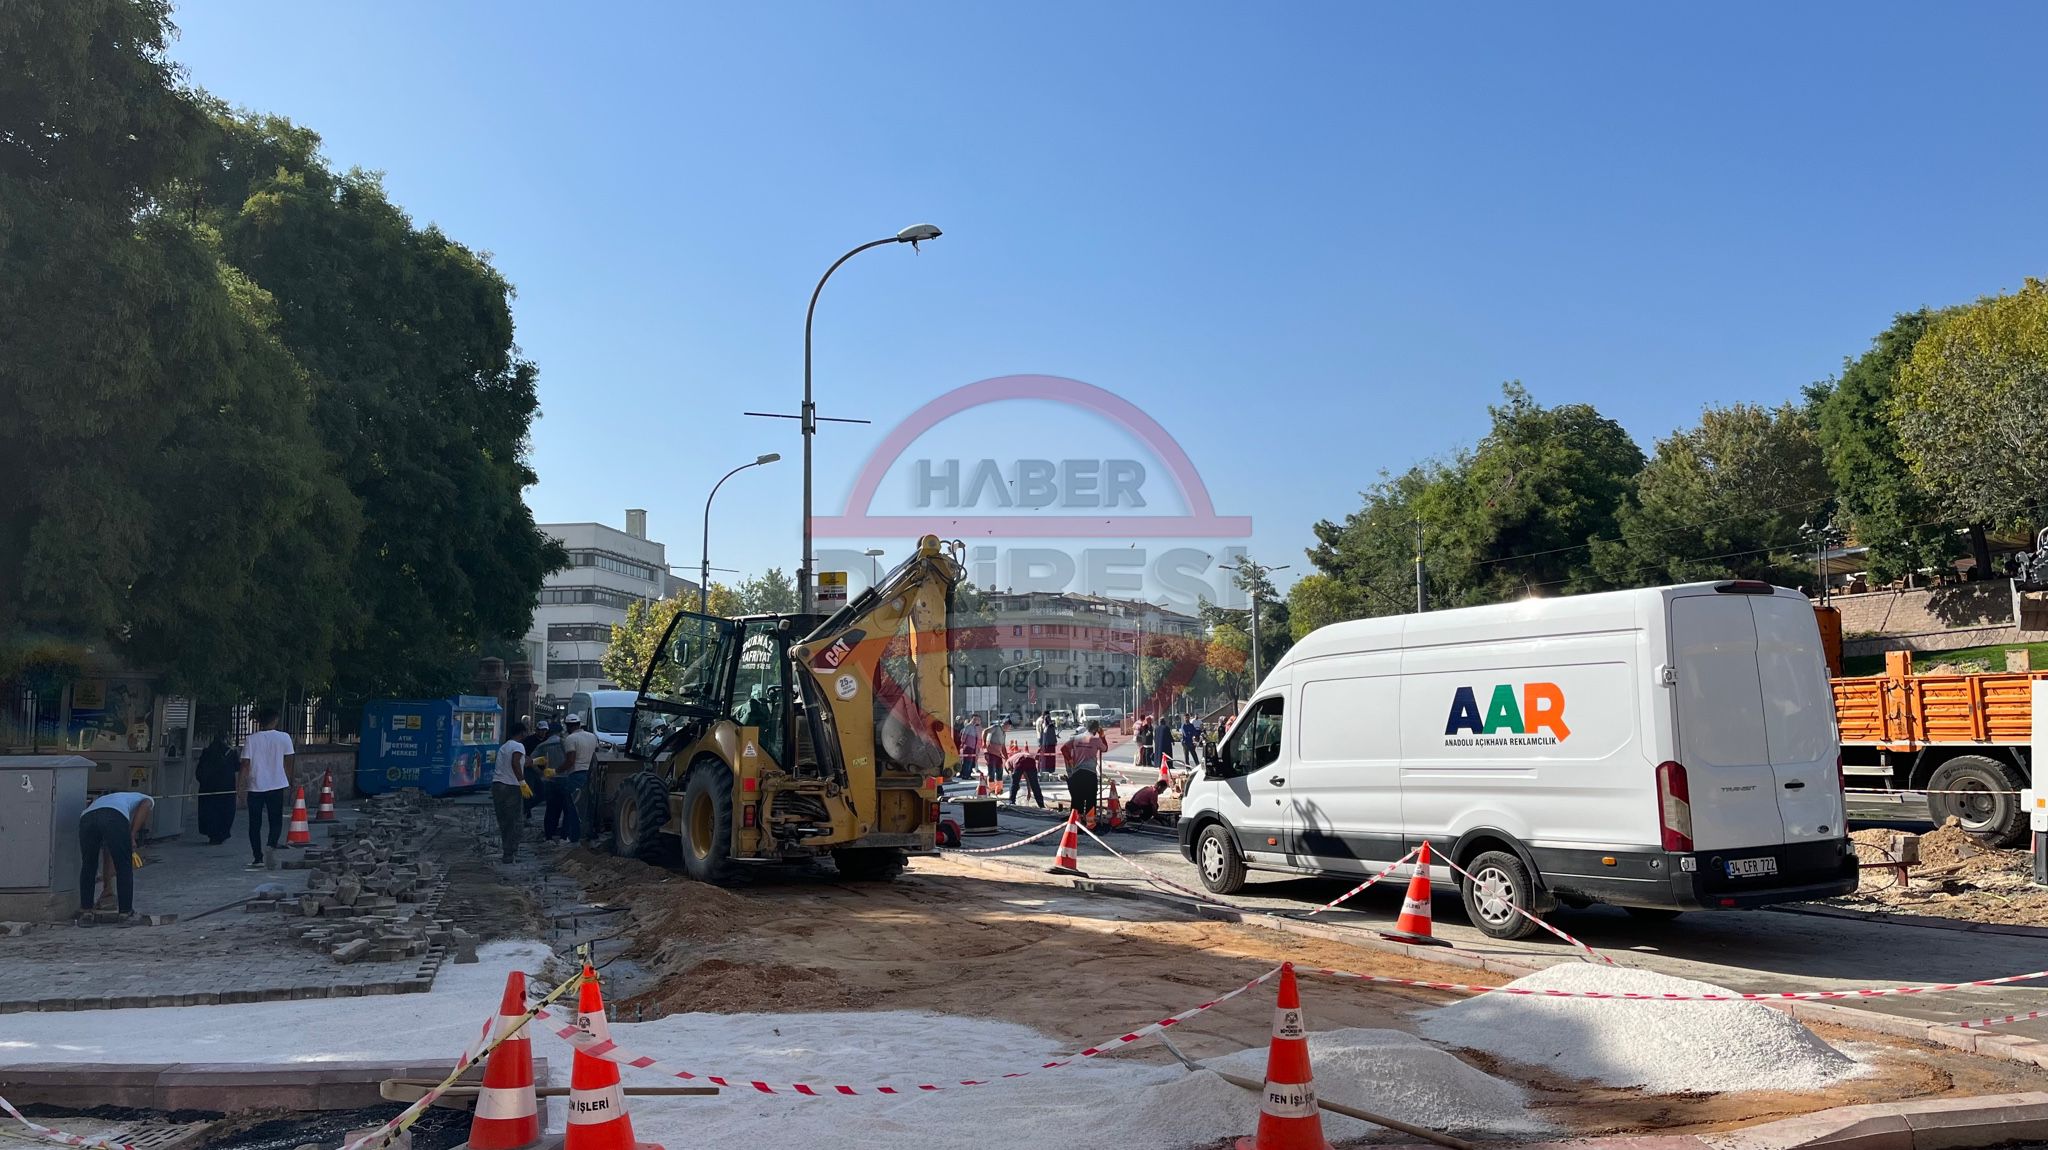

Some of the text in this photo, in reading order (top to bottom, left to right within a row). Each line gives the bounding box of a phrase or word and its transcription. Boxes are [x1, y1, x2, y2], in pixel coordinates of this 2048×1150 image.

[825, 637, 851, 667] CAT
[1444, 682, 1572, 743] AAR
[1444, 737, 1557, 748] ANADOLU AÇIKHAVA REKLAMCILIK
[1730, 858, 1776, 874] 34 CFR 722
[577, 1097, 609, 1114] İŞLERİ
[1269, 1093, 1287, 1105] FEN
